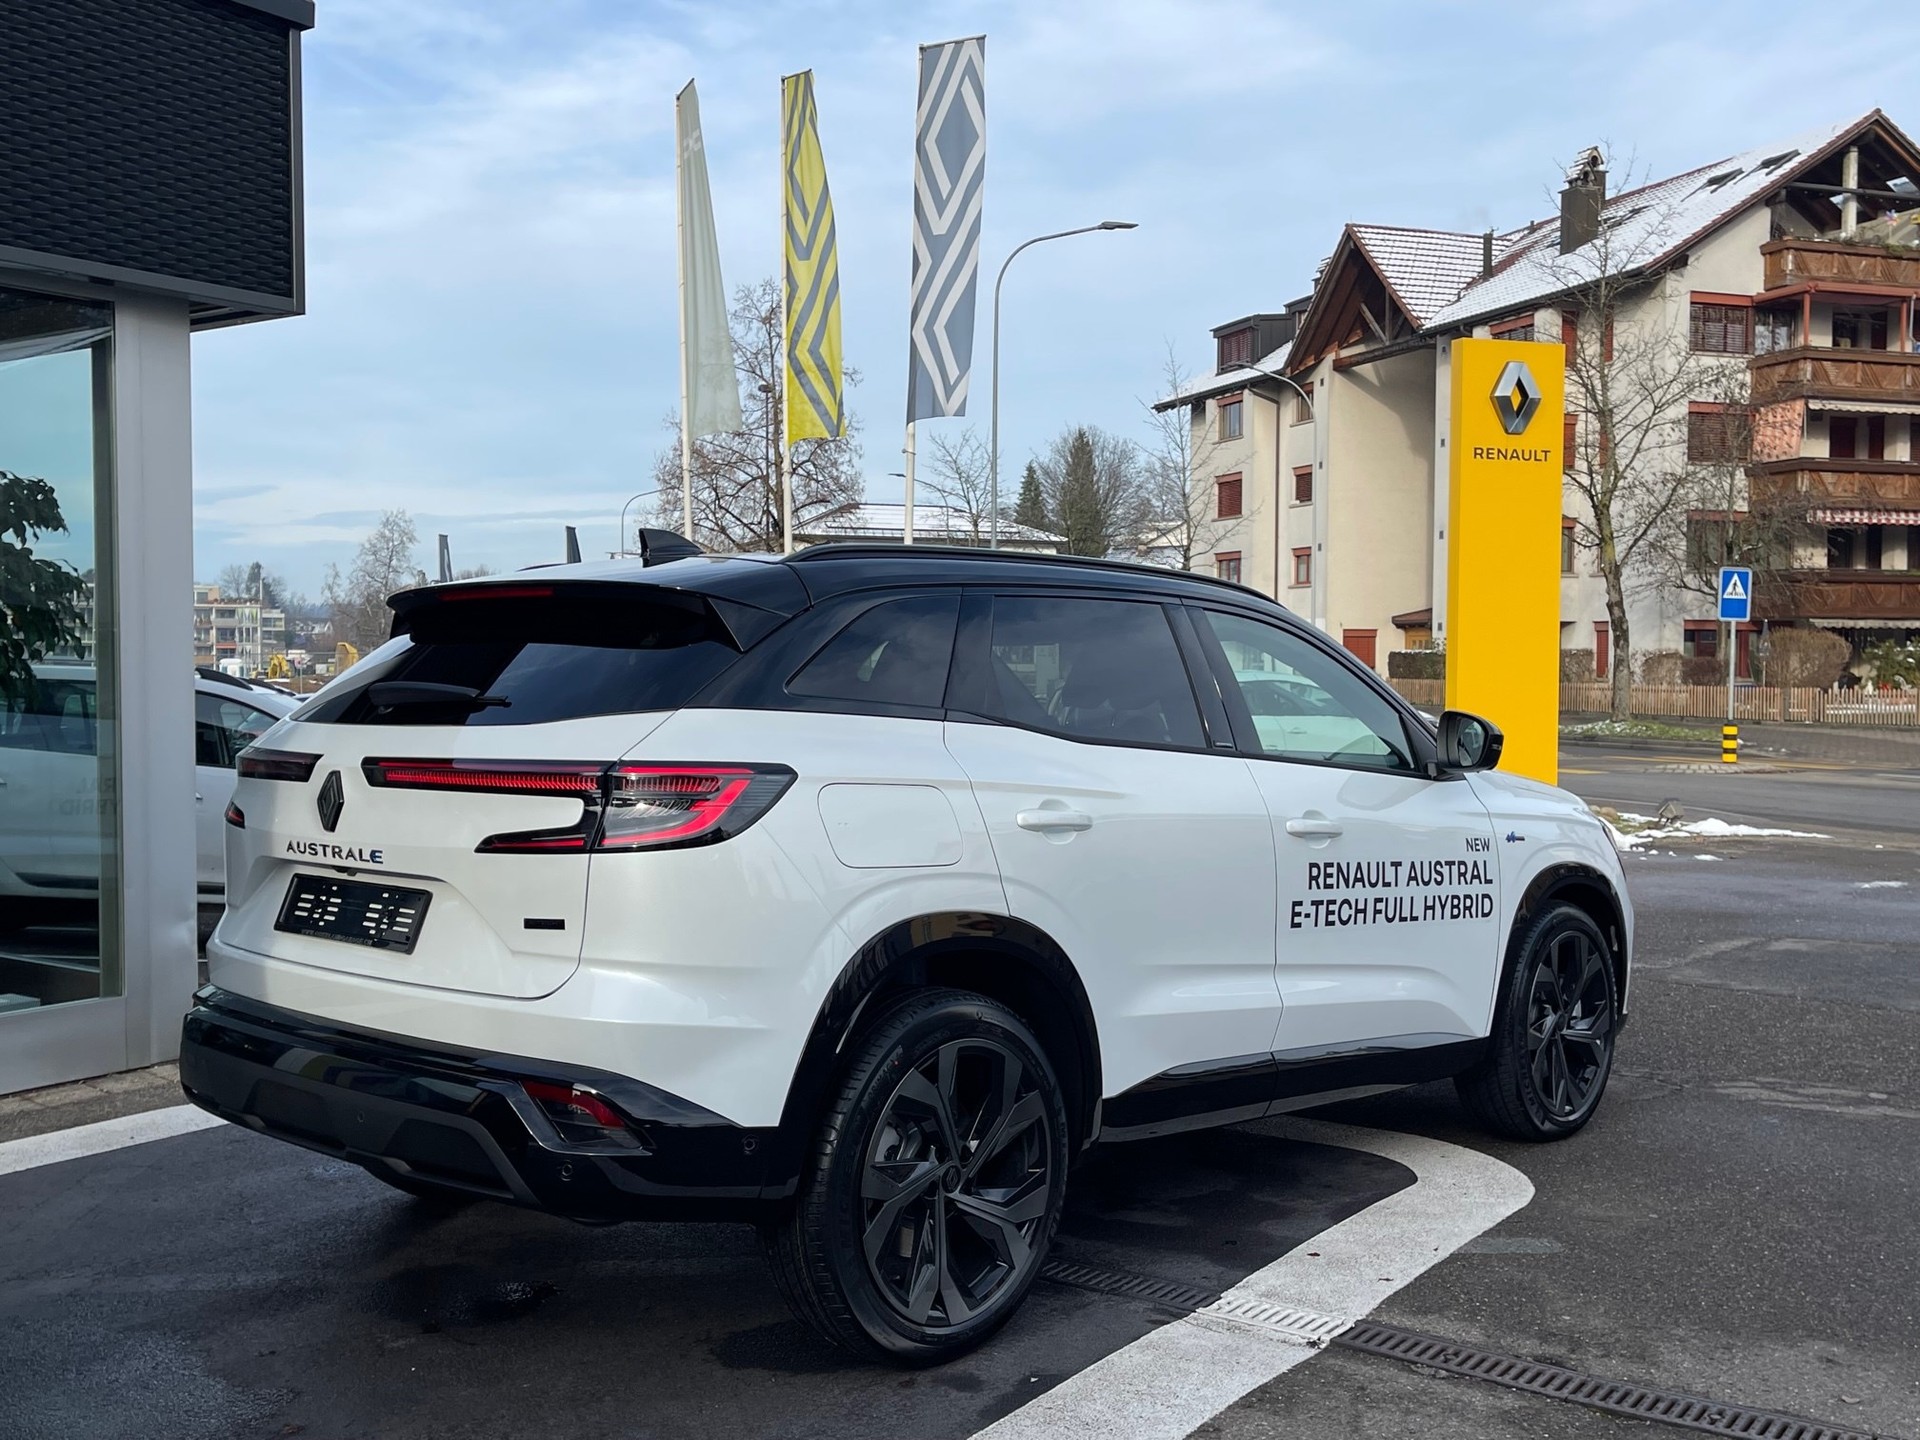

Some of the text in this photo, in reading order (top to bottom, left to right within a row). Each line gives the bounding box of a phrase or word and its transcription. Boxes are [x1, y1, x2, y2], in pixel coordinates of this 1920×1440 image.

[1473, 447, 1551, 462] RENAULT
[1465, 837, 1490, 852] NEW
[1308, 860, 1493, 890] RENAULT AUSTRAL
[1290, 893, 1494, 928] E-TECH FULL HYBRID
